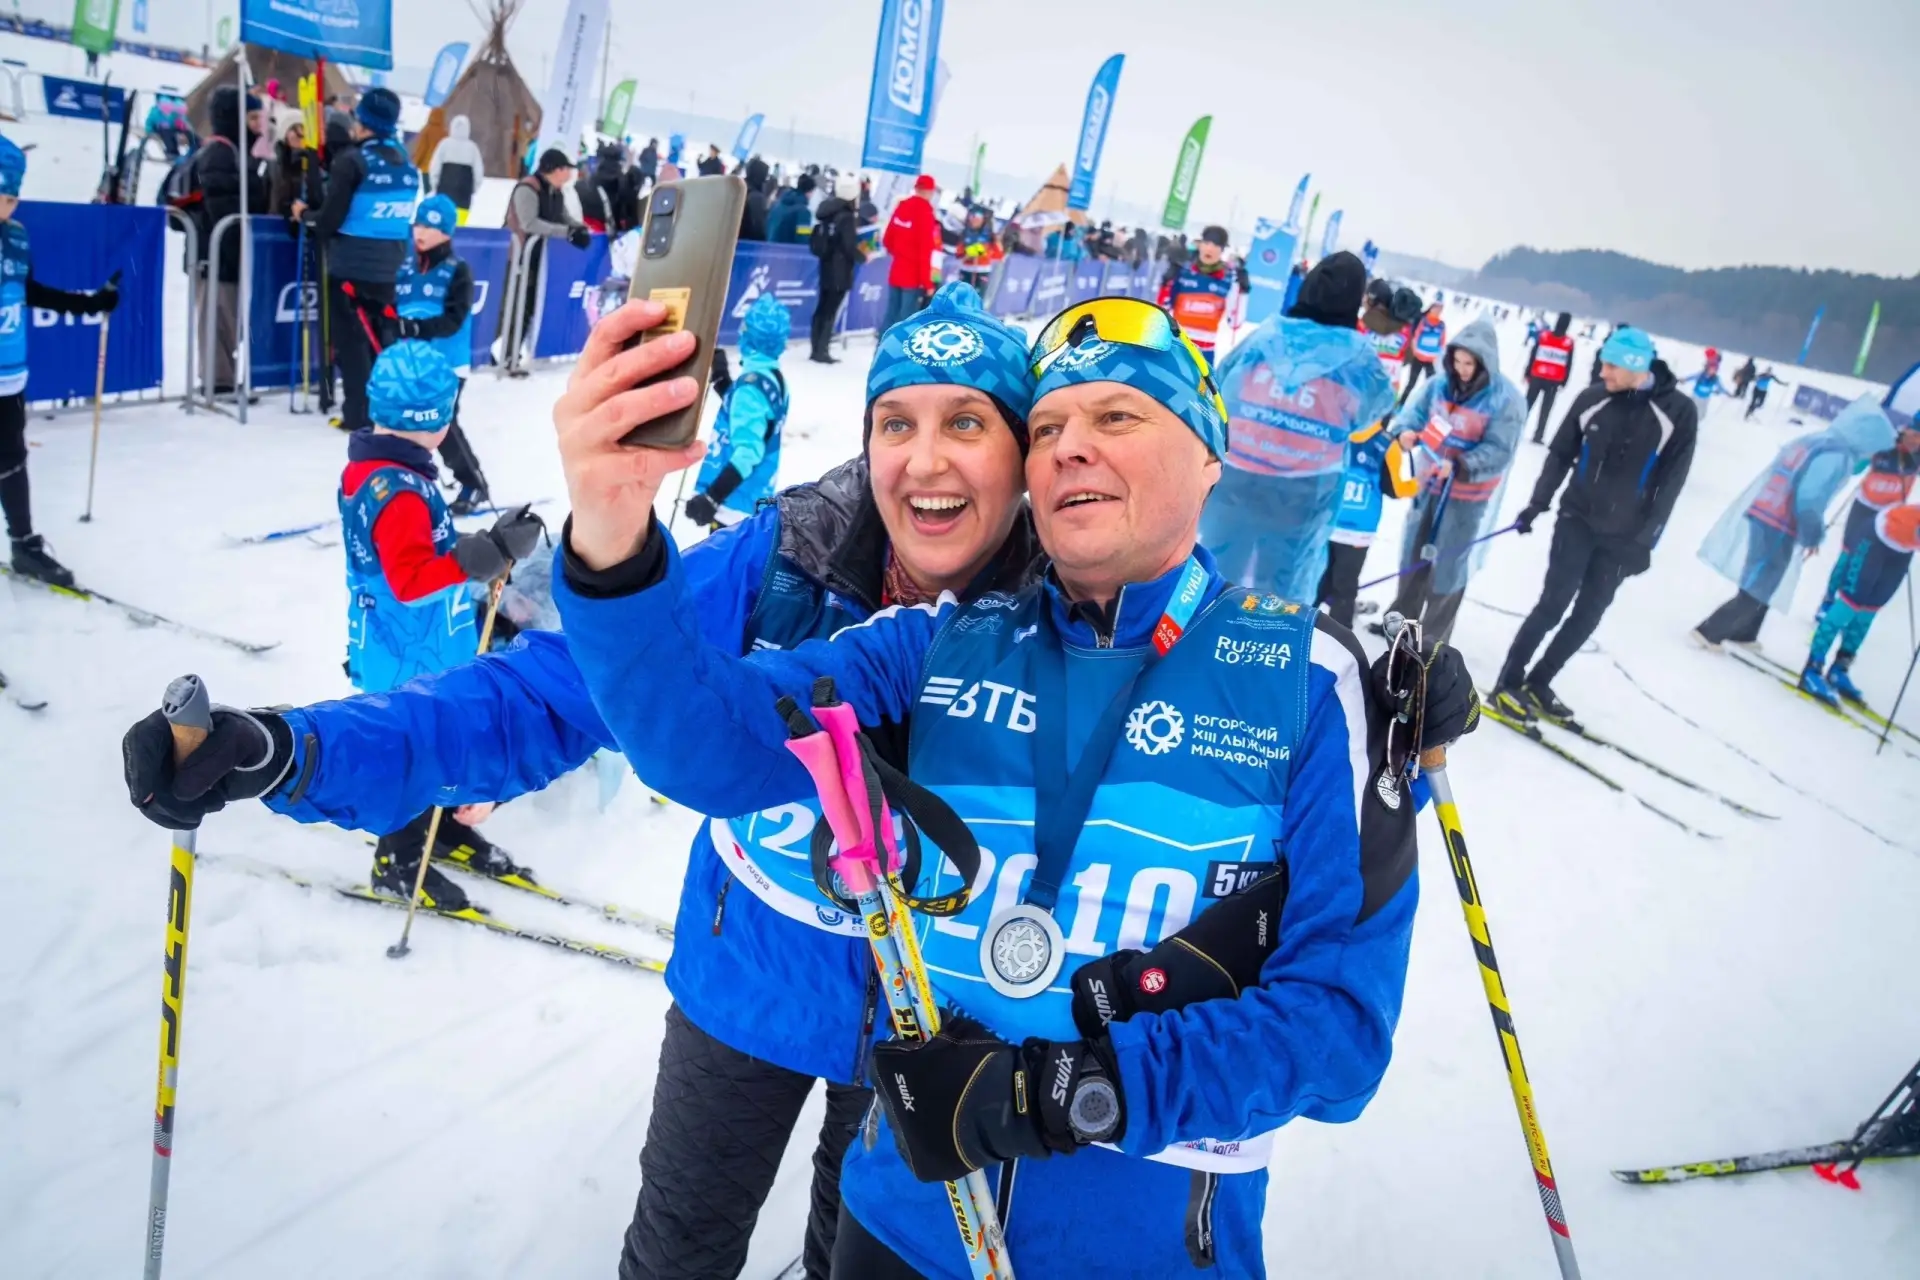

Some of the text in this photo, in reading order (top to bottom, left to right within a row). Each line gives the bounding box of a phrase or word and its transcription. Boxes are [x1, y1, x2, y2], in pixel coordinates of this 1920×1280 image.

[414, 409, 440, 422] ВТБ
[1214, 649, 1291, 670] LOPPET
[1216, 635, 1292, 658] RUSSIA
[947, 679, 1037, 734] ВТБ
[1194, 714, 1278, 743] ЮГОРСКИЙ
[1191, 744, 1269, 770] МАРАФОН
[1192, 728, 1291, 761] XIII ЛЫЖНЫЙ
[1213, 864, 1239, 897] 5
[1212, 1142, 1241, 1156] ЮГРА
[149, 1206, 168, 1262] AVANTI
